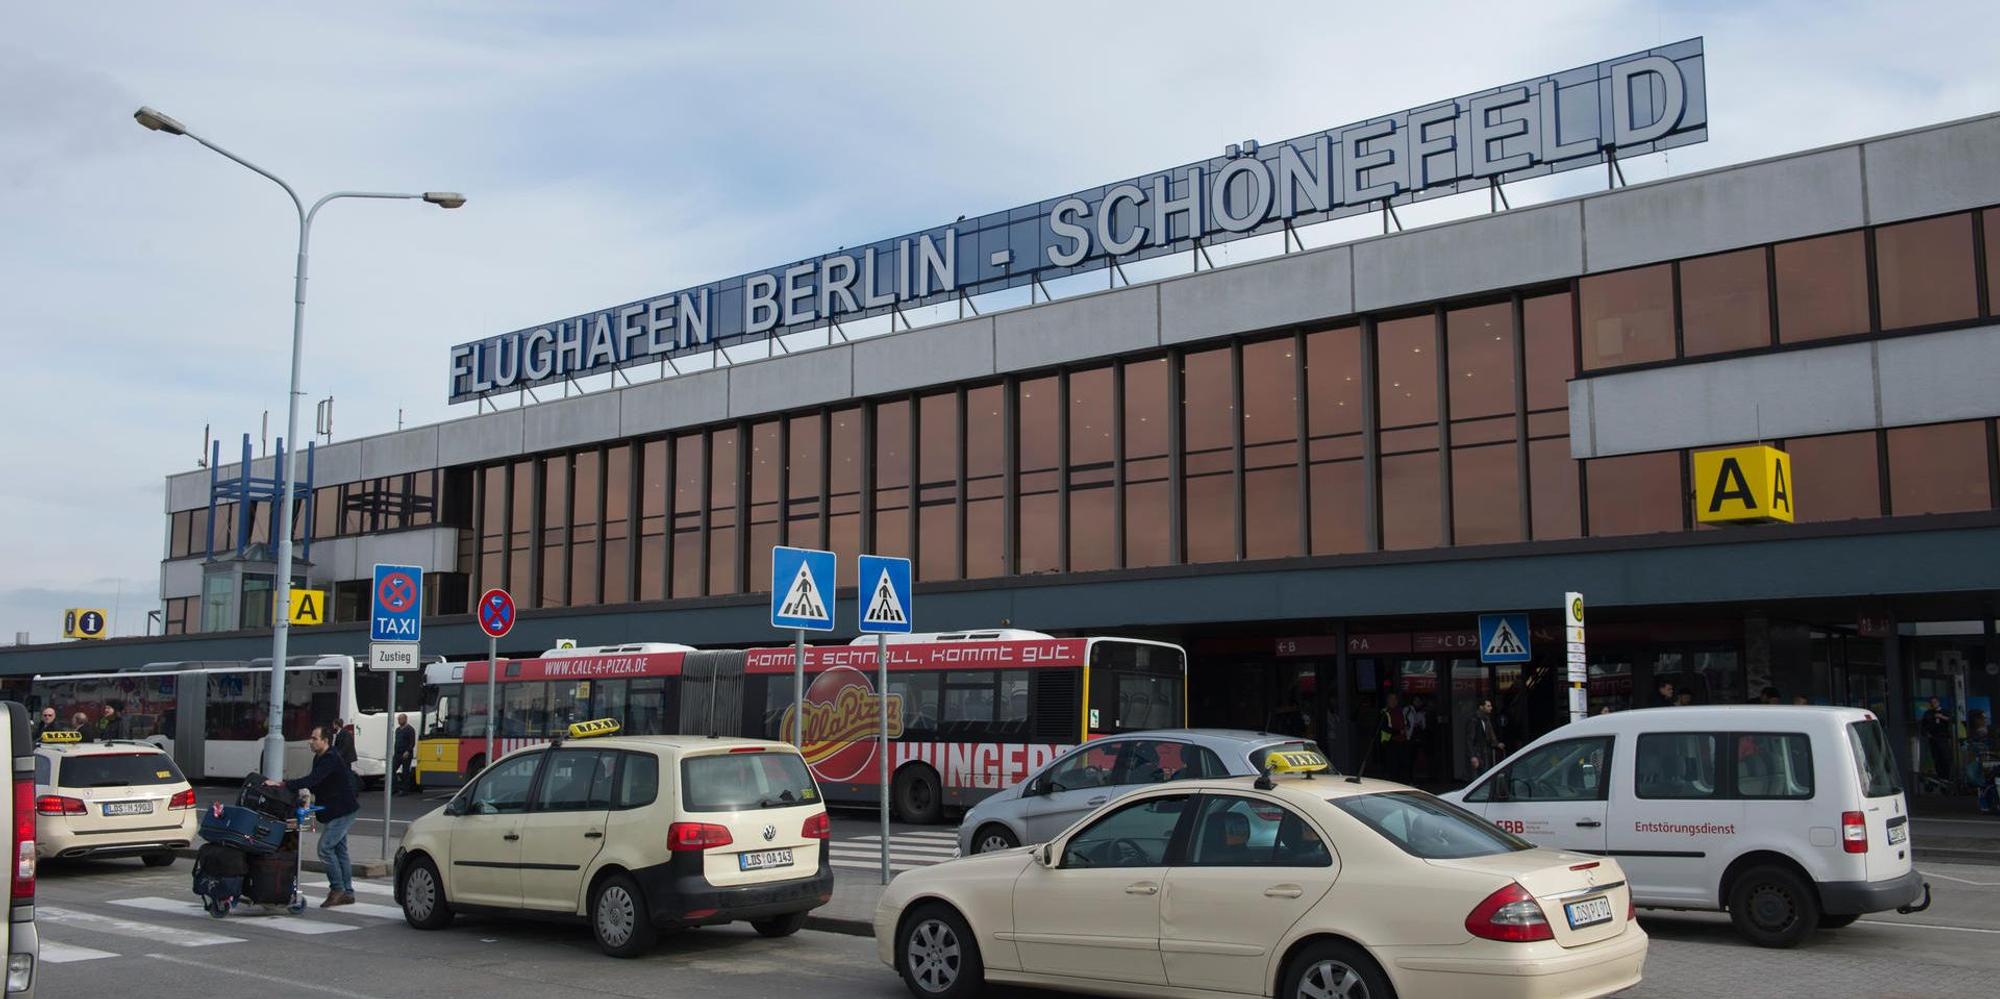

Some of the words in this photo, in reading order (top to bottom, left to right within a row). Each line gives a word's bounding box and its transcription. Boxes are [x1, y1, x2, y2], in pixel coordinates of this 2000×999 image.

[450, 288, 711, 397] FLUGHAFEN
[746, 228, 957, 334] BERLIN
[1046, 55, 1687, 268] SCHÖNEFELD
[1709, 458, 1758, 512] A
[1773, 458, 1790, 513] A
[296, 594, 317, 620] A
[377, 618, 416, 635] TAXI
[1288, 641, 1296, 652] B
[1361, 638, 1370, 649] A
[379, 651, 411, 664] Zustieg
[545, 658, 648, 676] WWW.CALL-A-PIZZA.DE
[582, 719, 615, 732] TAXI
[896, 742, 1076, 789] HUNGER
[1286, 754, 1322, 766] TAXI
[1635, 821, 1735, 837] Entstörungsdienst
[745, 854, 762, 866] LDS
